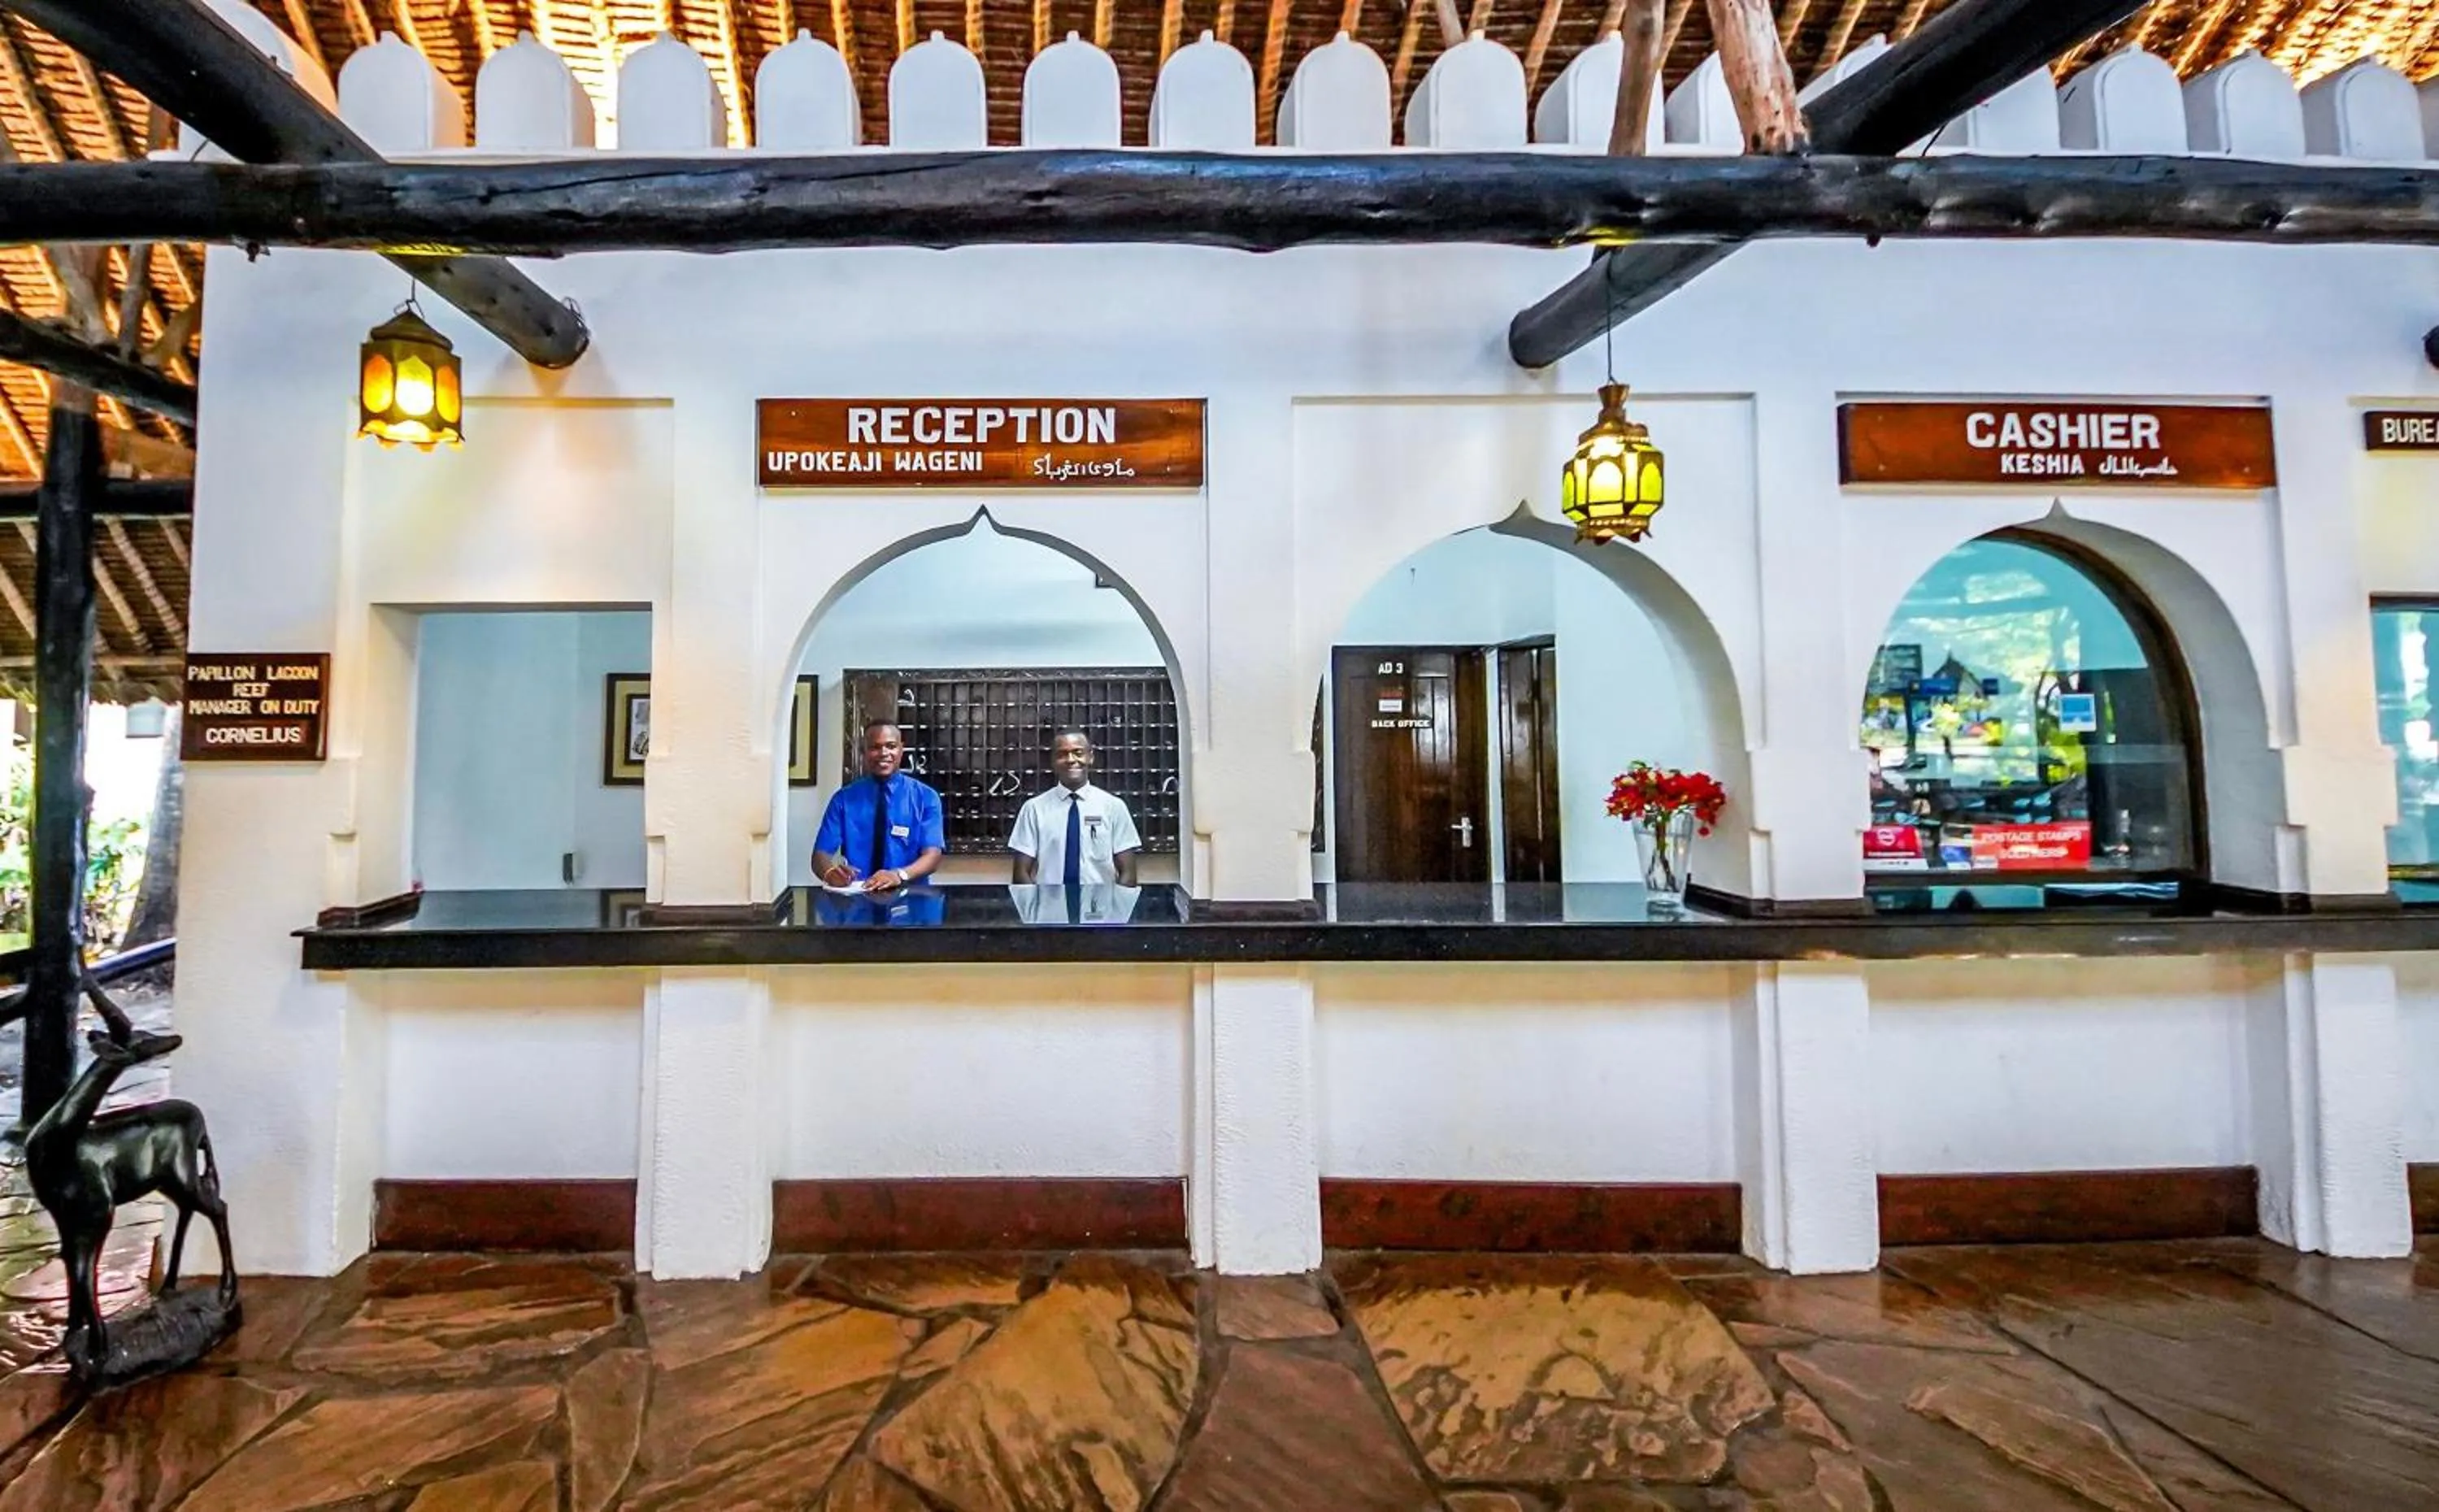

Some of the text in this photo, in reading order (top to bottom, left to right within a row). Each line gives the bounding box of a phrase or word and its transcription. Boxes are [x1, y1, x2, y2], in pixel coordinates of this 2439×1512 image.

[847, 406, 1116, 444] RECEPTION
[1965, 412, 2161, 450] CASHIER
[2382, 418, 2439, 443] BURE
[767, 451, 983, 472] UPOKEAJI WAGENI
[2000, 453, 2085, 474] KESHIA
[188, 666, 256, 680] PAPILLON
[1378, 662, 1404, 675] AD 3
[233, 683, 271, 697] REEF
[189, 700, 320, 715] MANAGER ON DUTY
[1372, 719, 1430, 728] BACK OFFICE
[206, 727, 302, 743] CORNELIUS
